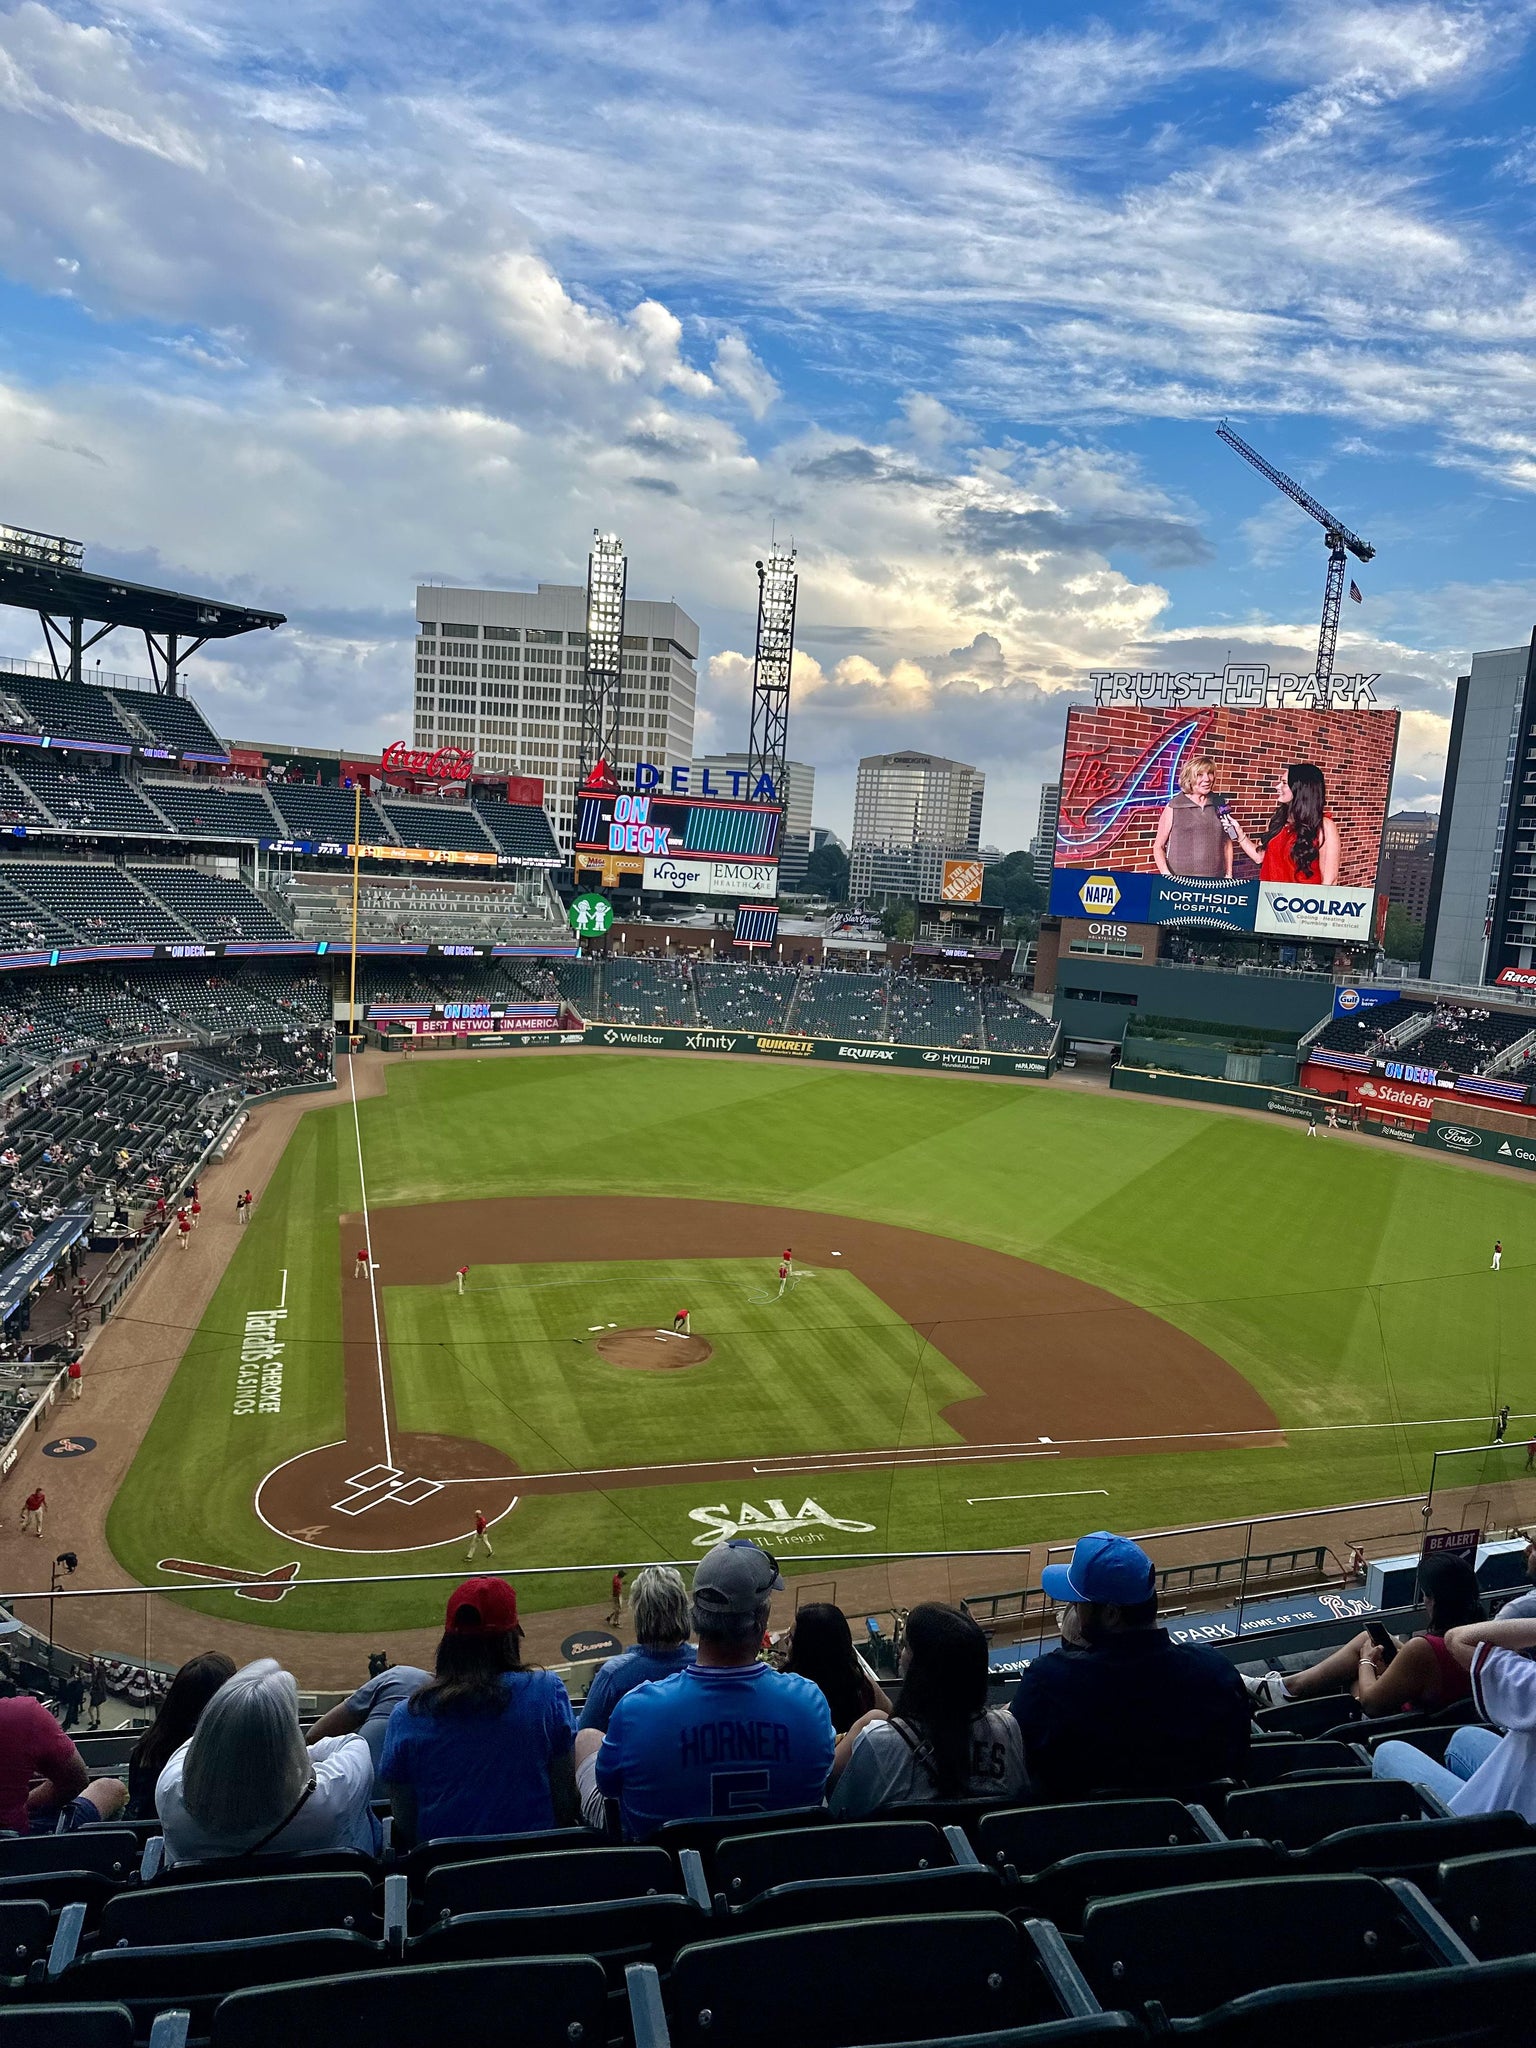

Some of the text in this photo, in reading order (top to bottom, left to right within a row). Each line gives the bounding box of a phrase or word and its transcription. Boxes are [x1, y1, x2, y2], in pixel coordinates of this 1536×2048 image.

[1090, 672, 1382, 702] TRUIST PARK
[636, 763, 776, 800] DELTA
[614, 794, 650, 824] ON
[608, 824, 671, 856] DECK
[654, 862, 700, 888] Kroger
[714, 864, 775, 881] EMORY
[942, 862, 982, 899] HOME
[948, 865, 965, 880] THE
[958, 878, 981, 900] DEPOT
[1085, 886, 1115, 904] NAPA
[1160, 890, 1248, 906] NORTHSIDE
[1174, 903, 1230, 914] HOSPITAL
[1273, 896, 1366, 918] COOLRAY
[1088, 923, 1127, 937] ORIS
[1502, 970, 1536, 984] Race
[444, 1004, 460, 1019] ON
[461, 1004, 490, 1019] DECK
[423, 1021, 448, 1030] BEST
[515, 1019, 559, 1029] AMERICA
[620, 1032, 663, 1044] Wellstar
[686, 1034, 736, 1051] xfinity
[757, 1038, 814, 1052] QUIKRETE
[839, 1046, 894, 1060] EQUIFAX
[942, 1053, 991, 1066] HYUNDAI
[1385, 1063, 1404, 1079] ON
[1405, 1066, 1438, 1086] DECK
[1444, 1128, 1474, 1144] Ford
[1515, 1148, 1536, 1161] Geo
[241, 1309, 288, 1362] Harrah's
[233, 1364, 260, 1416] CASINOS
[258, 1362, 283, 1414] CHEROKEE
[688, 1497, 876, 1546] SAIA
[776, 1533, 825, 1544] Freight
[1430, 1533, 1475, 1550] BE ALERT
[1174, 1623, 1238, 1643] PARK
[1241, 1617, 1277, 1630] HOME
[1278, 1615, 1293, 1624] OF
[1295, 1611, 1317, 1620] THE
[680, 1720, 790, 1767] HORNER
